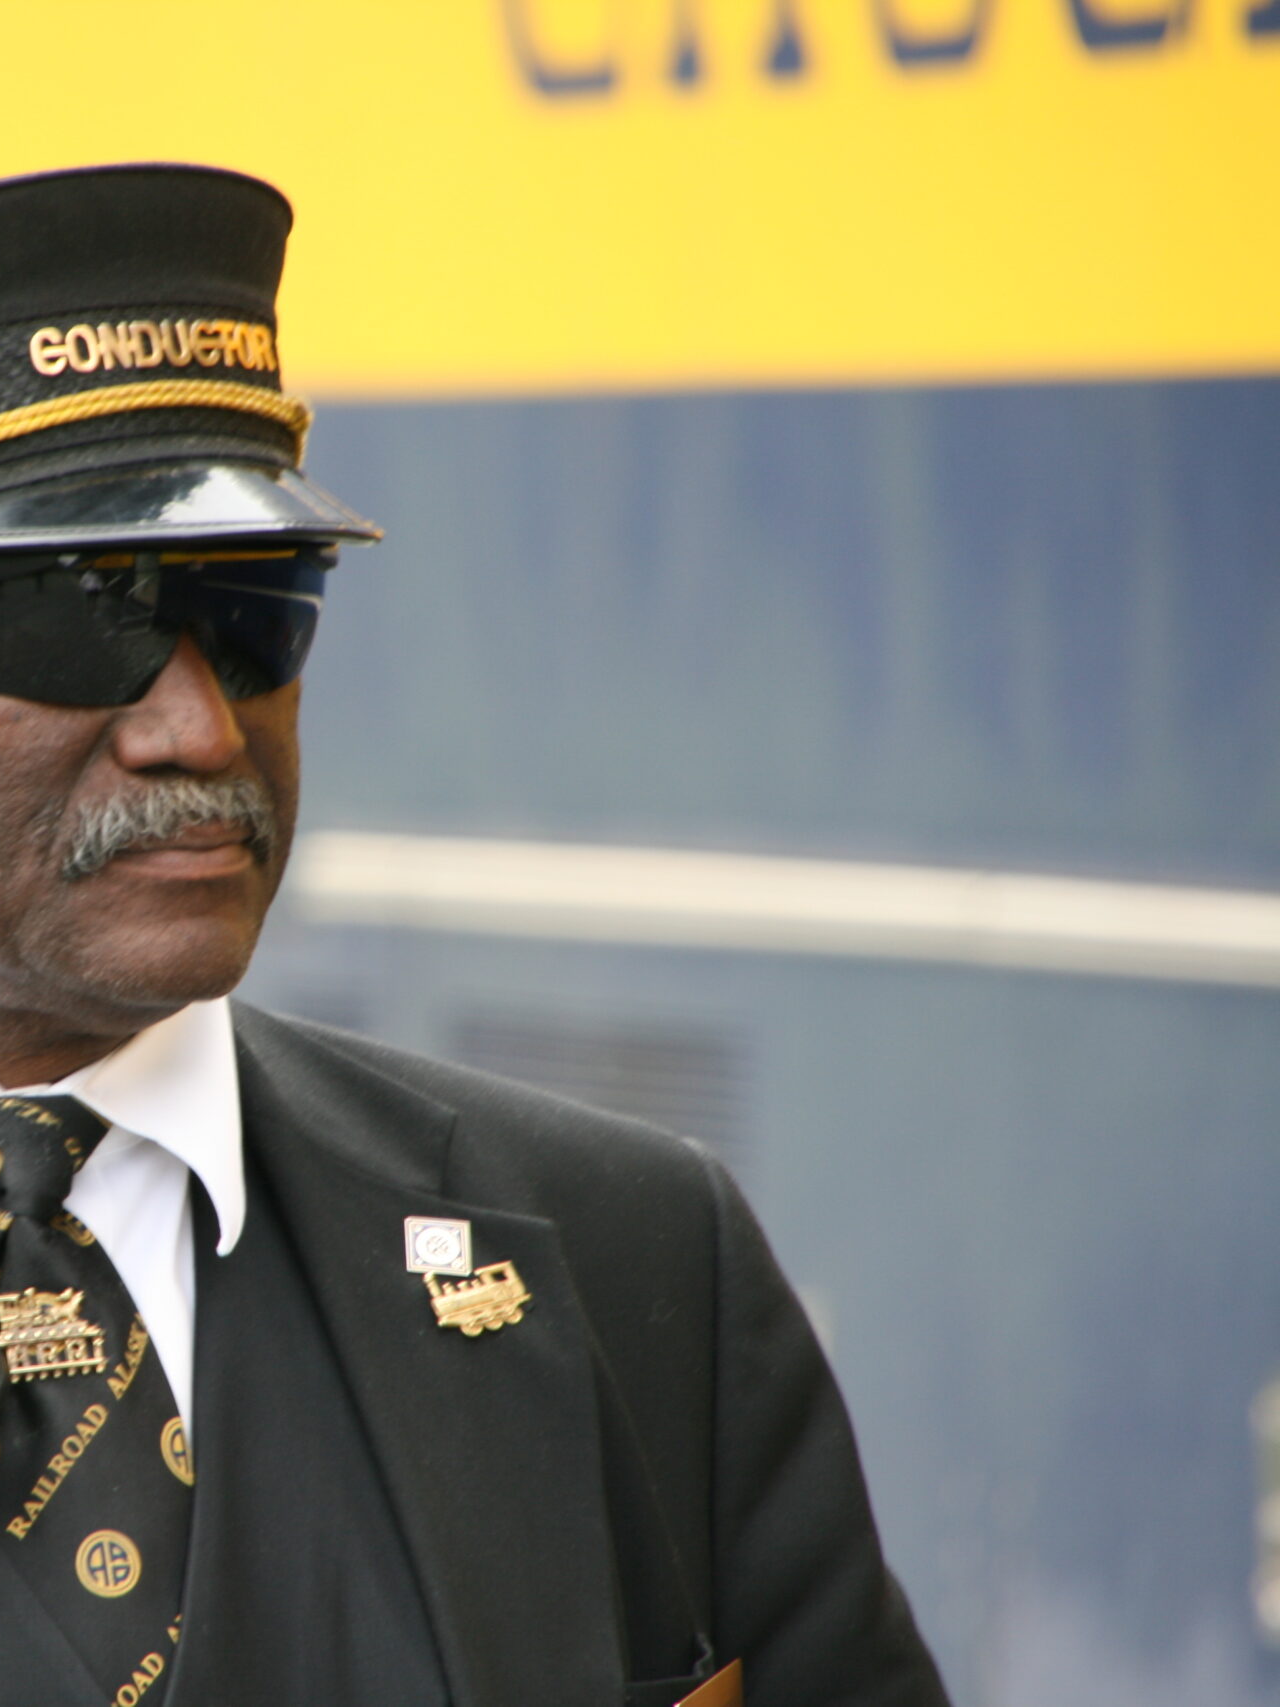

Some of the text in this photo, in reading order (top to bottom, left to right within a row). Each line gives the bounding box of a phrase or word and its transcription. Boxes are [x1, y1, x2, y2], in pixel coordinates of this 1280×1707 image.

[30, 319, 277, 376] CONDUCTOR
[7, 1403, 110, 1540] RAILROAD
[110, 1652, 165, 1707] OAD
